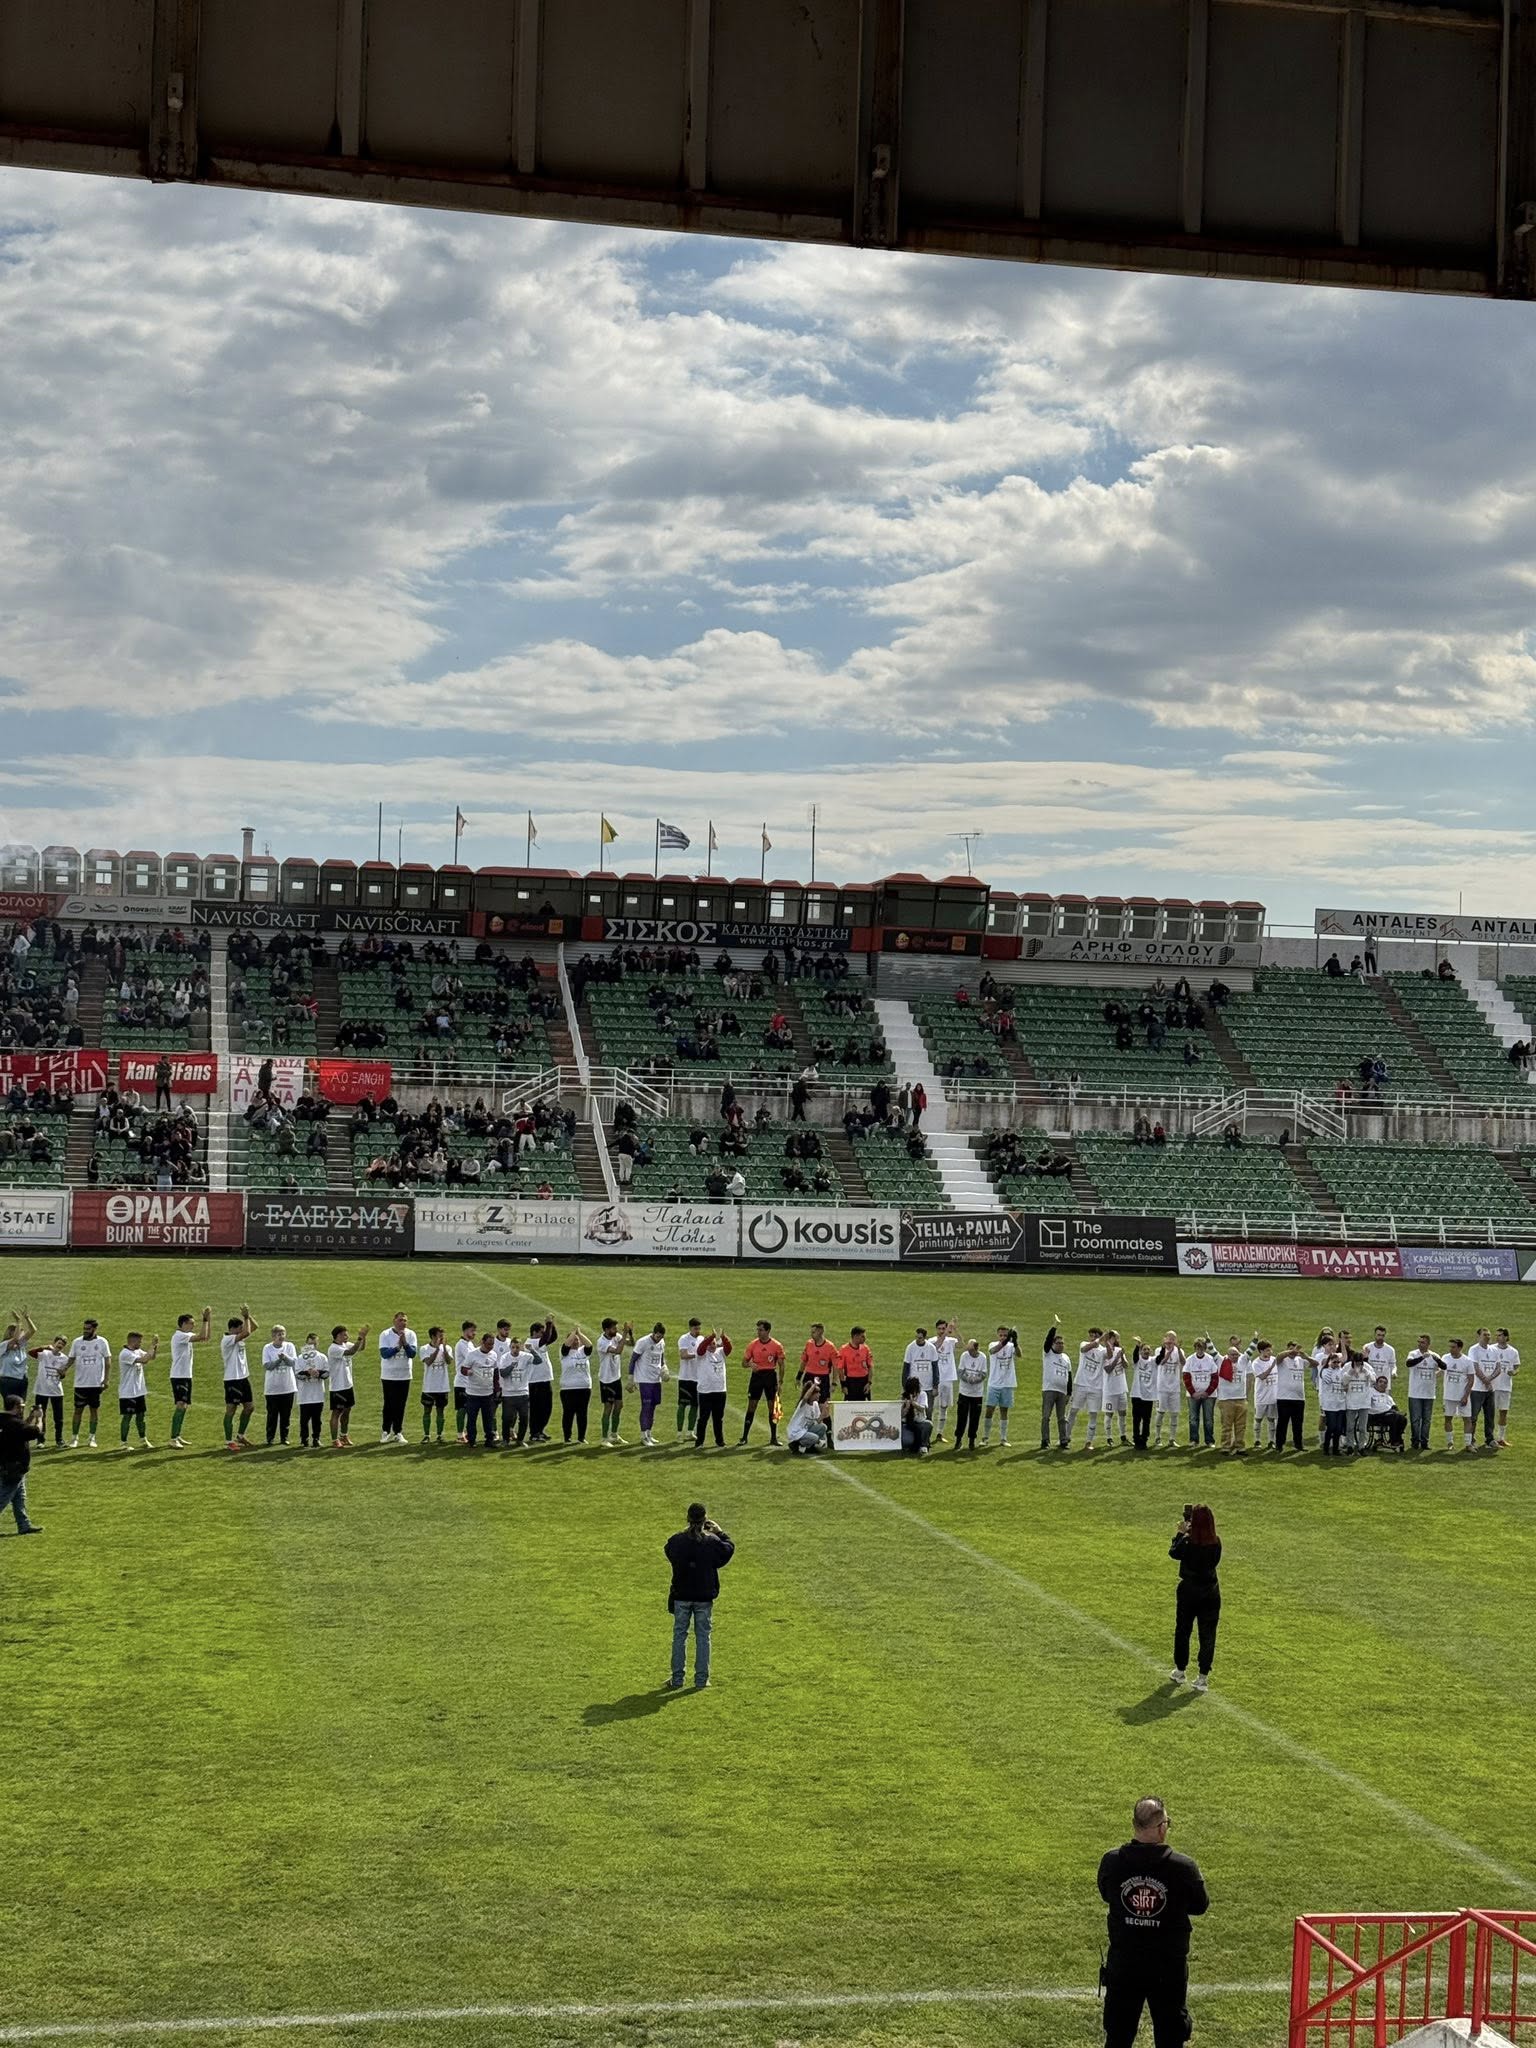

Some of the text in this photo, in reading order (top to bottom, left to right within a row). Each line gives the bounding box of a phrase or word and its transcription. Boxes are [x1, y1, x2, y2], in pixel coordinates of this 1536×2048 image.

[1352, 914, 1438, 930] ANTALES
[604, 918, 717, 944] ΣΙΣΚΟΣ
[721, 923, 849, 939] ΚΑΤΑΣΚΕΥΑΣΤΙΚΗ
[1145, 943, 1215, 956] ΟΓΛΟΥ
[1070, 951, 1213, 965] ΚΑΤΑΣΚΕΥΑΣΤΙΚΗ
[352, 1071, 385, 1085] ΞΑΝΘΗ
[0, 1211, 56, 1224] STATE
[265, 1203, 408, 1230] ΕΔΕΣΜΑ
[421, 1206, 576, 1225] Hotel Z Palace
[642, 1206, 726, 1225] Παλαιά
[1072, 1220, 1102, 1234] The
[106, 1225, 210, 1244] BURN THE STREET
[268, 1233, 392, 1245] ΨΗΤΟΠΩΛΕΙΟΝ
[456, 1238, 532, 1248] & Congress Center
[919, 1235, 1010, 1251] printing/sign/t-shirt
[1073, 1237, 1164, 1251] roommates
[1039, 1251, 1105, 1260] Design & Construct
[1214, 1245, 1297, 1262] ΜΕΤΑΛΛΕΜΠΟΡΙΚΗ
[1311, 1249, 1399, 1267] ΠΛΑΤΗΣ
[1413, 1255, 1500, 1265] ΚΑΡΚΑΝΗΣ ΣΤΕΦΑΝΟΣ
[1324, 1266, 1391, 1275] ΧΟΙΡΙΝΑ
[1124, 1916, 1161, 1928] SECURITY
